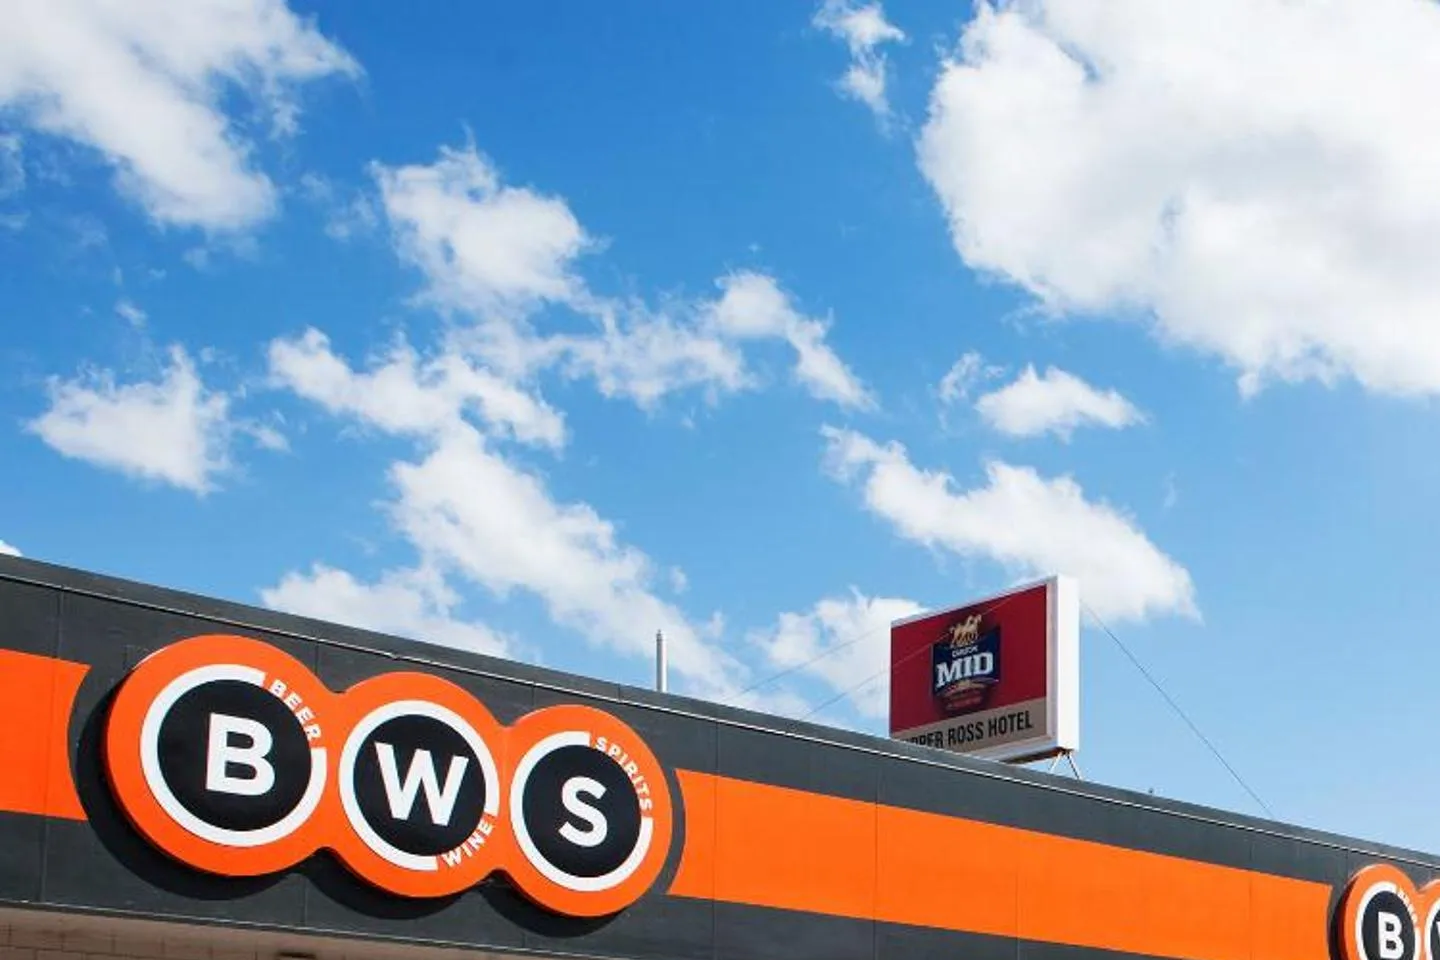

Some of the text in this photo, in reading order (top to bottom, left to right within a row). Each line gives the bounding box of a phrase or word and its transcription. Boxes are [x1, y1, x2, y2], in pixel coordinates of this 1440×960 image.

[935, 651, 994, 689] MID
[268, 678, 322, 742] BEER
[905, 710, 1033, 749] PER ROSS HOTEL
[595, 736, 653, 811] SPIRITS
[440, 820, 494, 868] WINE
